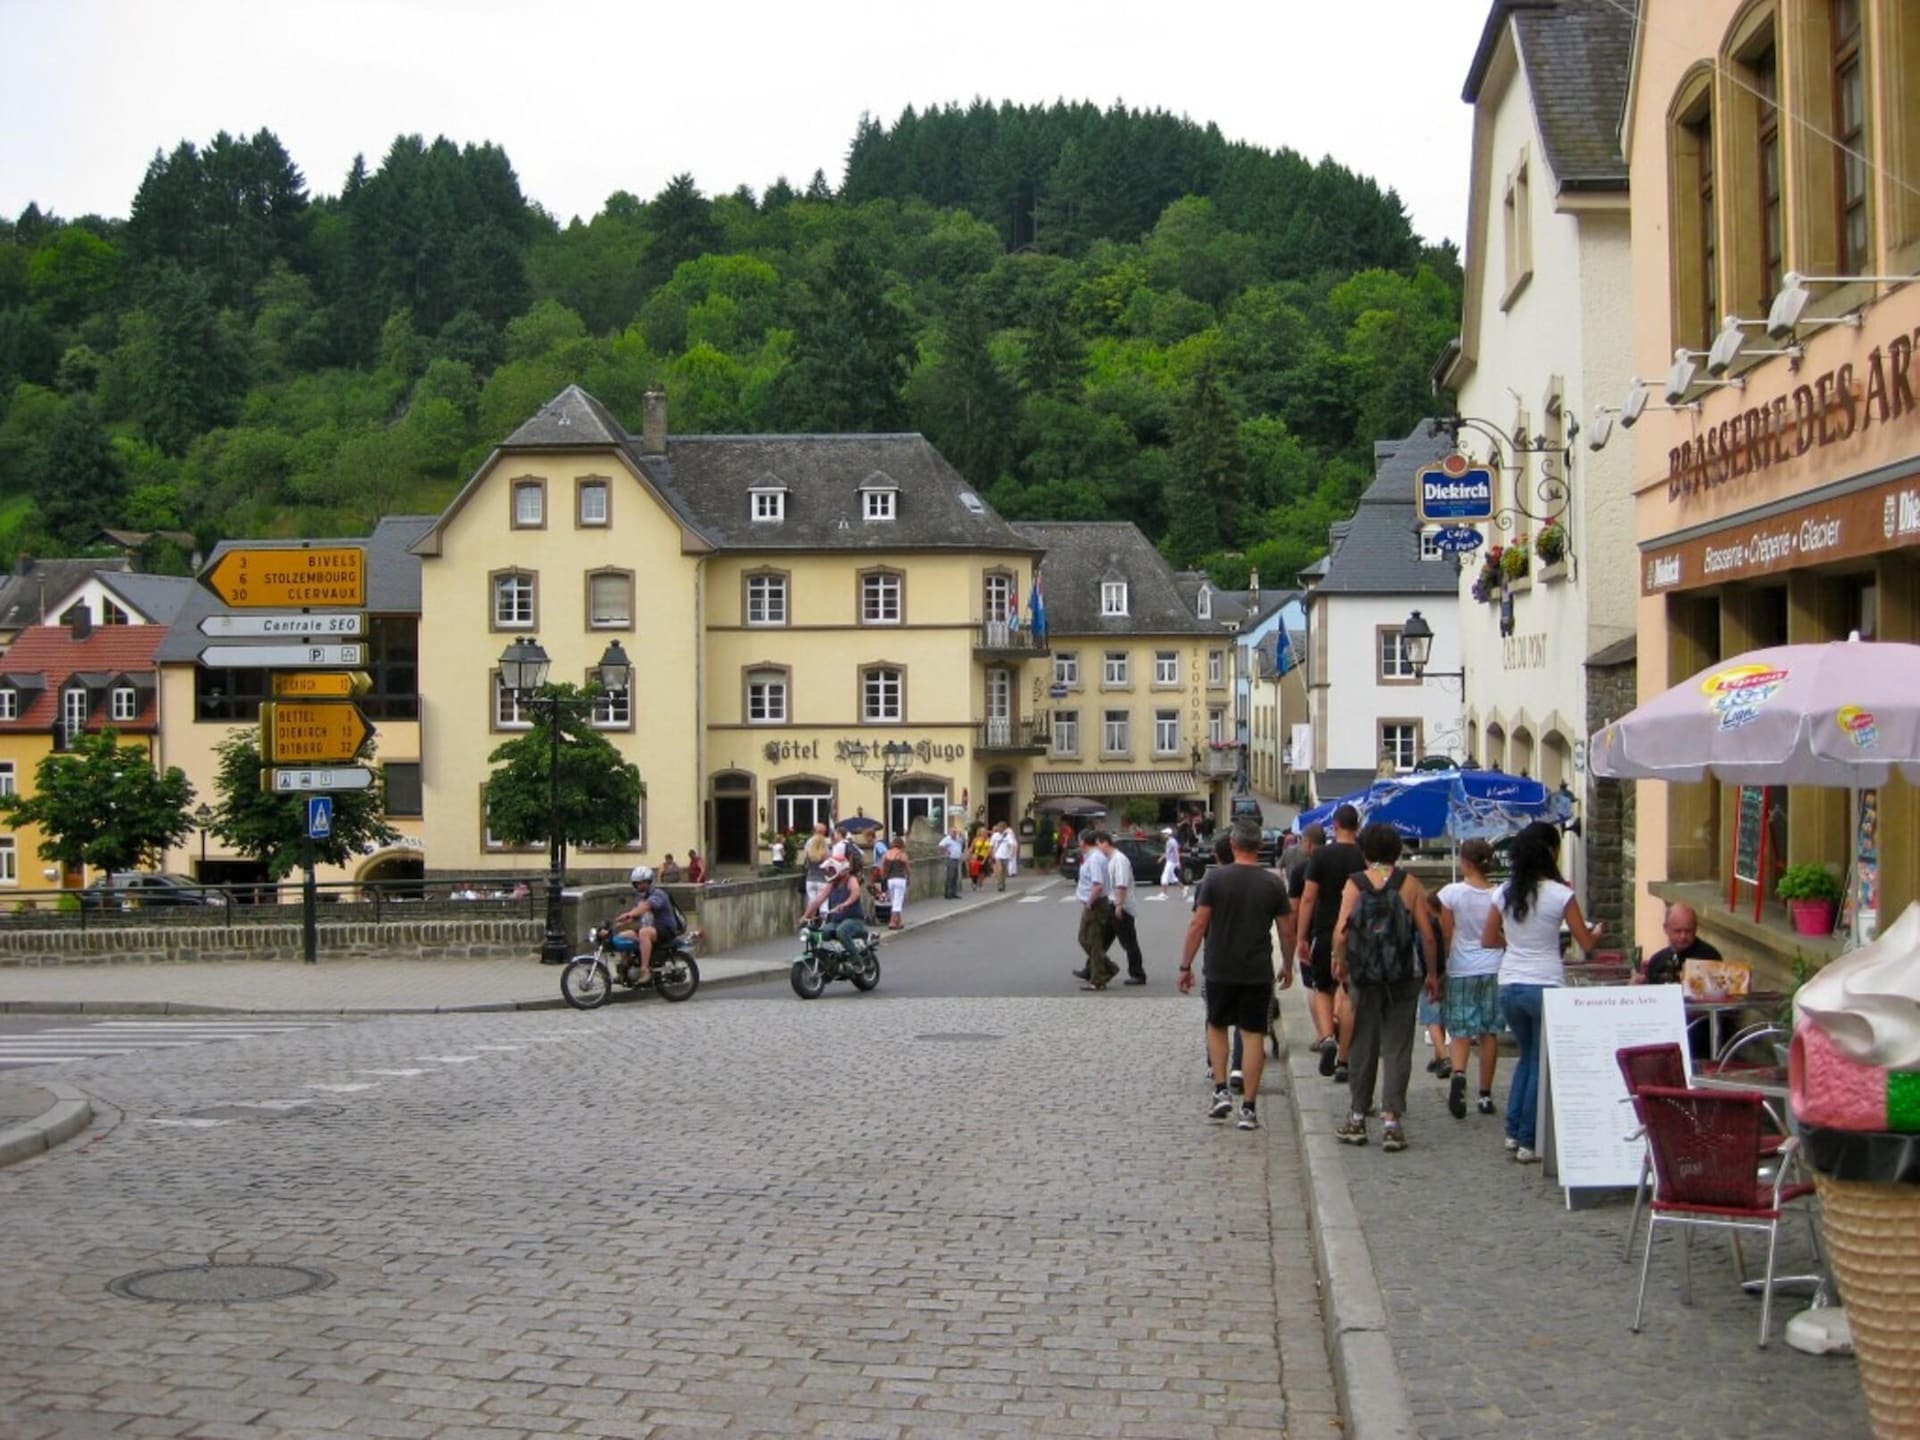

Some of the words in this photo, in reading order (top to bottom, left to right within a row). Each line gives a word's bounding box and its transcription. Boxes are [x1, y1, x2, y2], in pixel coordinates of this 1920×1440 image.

[1668, 393, 1790, 503] BRASSERIE
[1793, 363, 1857, 458] DES
[1424, 481, 1489, 500] Diekirch
[1704, 540, 1743, 574] Brasserie
[1749, 528, 1790, 568] Crêperie
[1799, 514, 1841, 552] Glacier
[308, 555, 356, 568] BIVELS
[239, 573, 247, 585] 6
[264, 571, 356, 584] STOLZEMBOURG
[232, 589, 248, 601] 30
[287, 588, 356, 600] CLERVAUX
[263, 619, 322, 632] Centrale
[329, 618, 356, 631] SEO
[763, 736, 819, 764] Hôtel
[915, 739, 965, 764] Hugo
